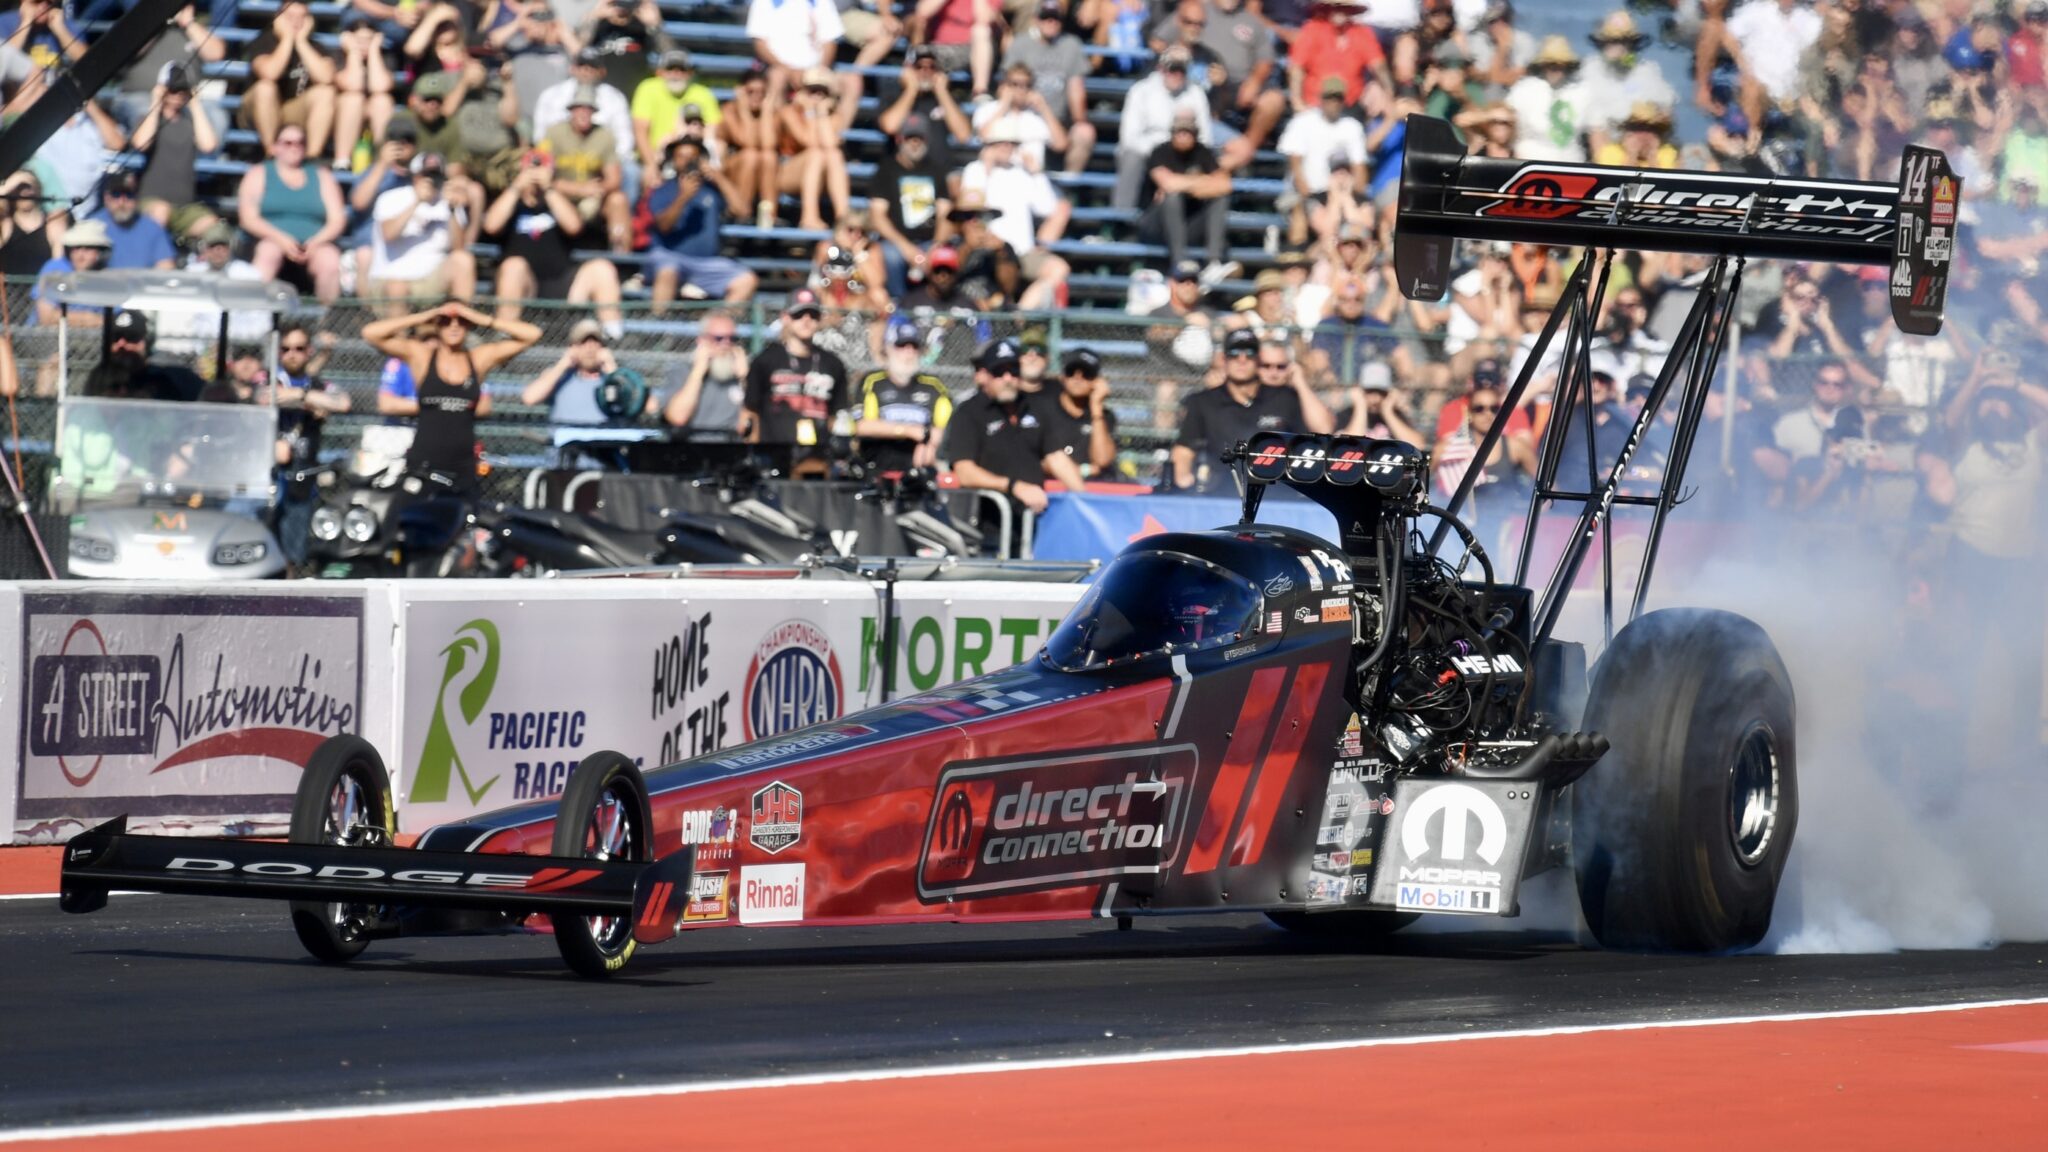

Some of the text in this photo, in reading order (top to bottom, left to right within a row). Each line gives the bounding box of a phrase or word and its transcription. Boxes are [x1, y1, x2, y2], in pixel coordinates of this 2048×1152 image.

[1901, 154, 1930, 204] 14
[1931, 155, 1942, 170] TF
[1892, 286, 1912, 297] TOOLS
[759, 622, 829, 662] CHAMPIONSHIP
[858, 616, 1061, 692] NORT
[652, 611, 711, 721] HOME
[1452, 654, 1523, 674] HEMI
[42, 632, 354, 759] A STREET Automotive
[757, 654, 830, 738] NHRA
[489, 711, 585, 750] PACIFIC
[754, 787, 800, 825] JHG
[994, 772, 1137, 830] direct
[682, 809, 737, 845] CODE 3
[758, 834, 791, 849] GARAGE
[165, 857, 534, 888] DODGE
[1400, 865, 1501, 886] MOPAR
[746, 876, 799, 909] Rinnai
[1401, 887, 1465, 907] Mobil
